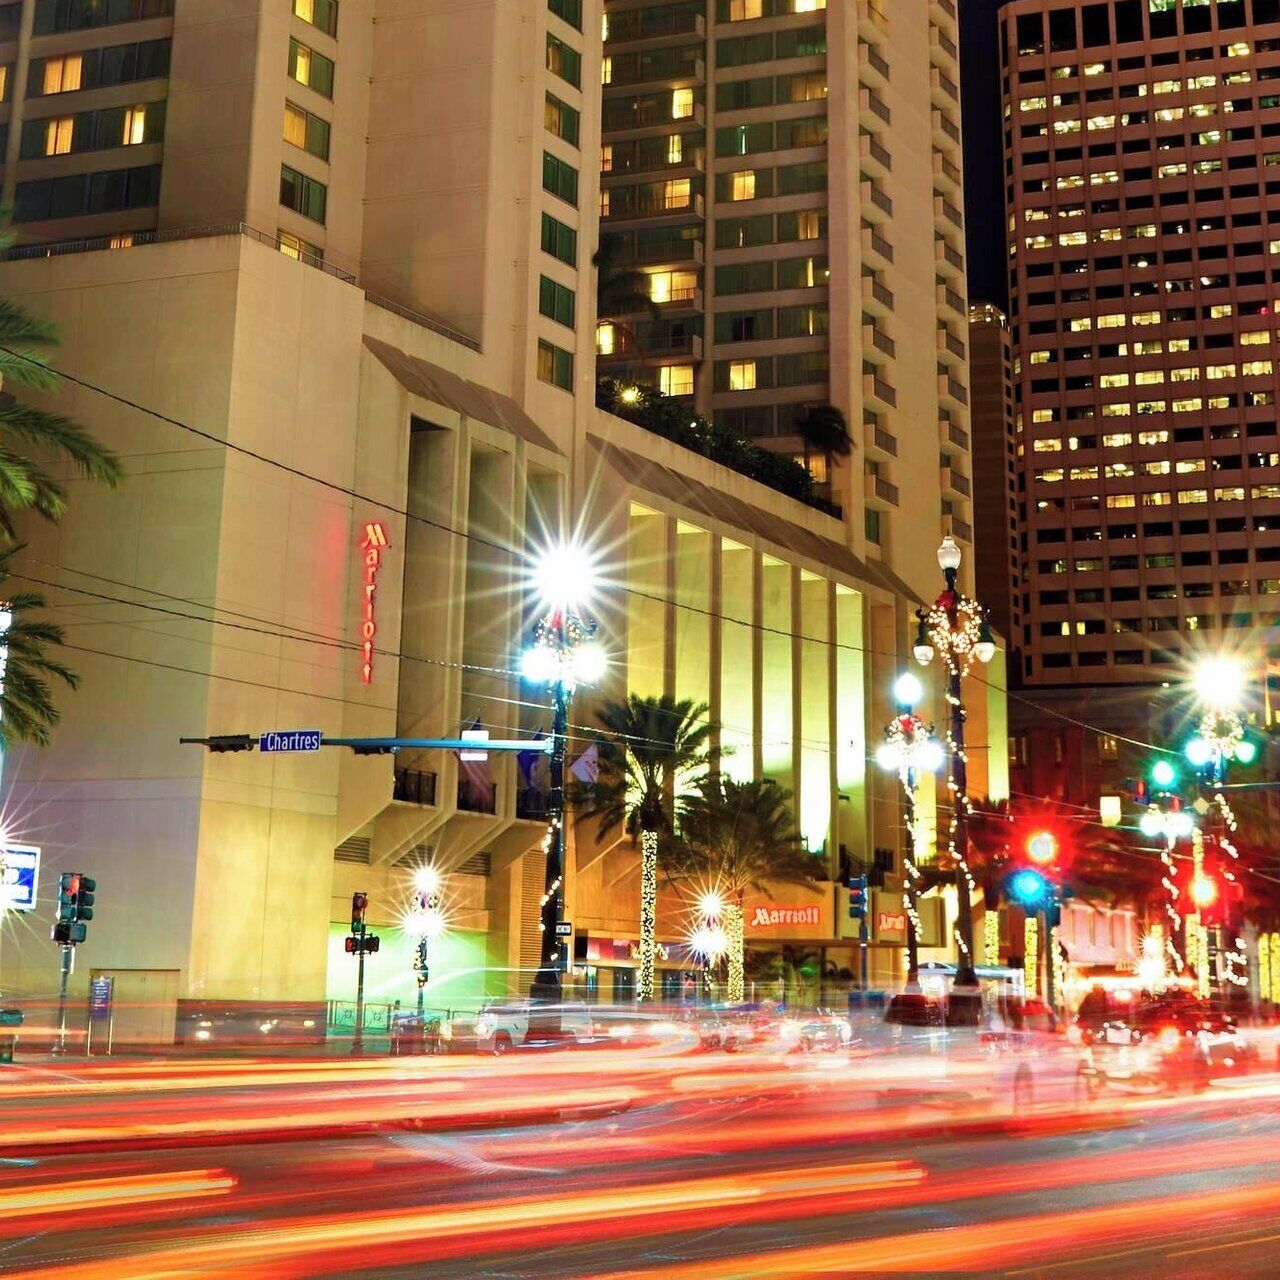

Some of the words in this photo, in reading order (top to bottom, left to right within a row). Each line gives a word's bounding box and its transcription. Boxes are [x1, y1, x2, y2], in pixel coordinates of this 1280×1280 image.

[360, 523, 387, 685] Marriott
[267, 733, 318, 751] Chartres
[751, 906, 819, 927] Marriott
